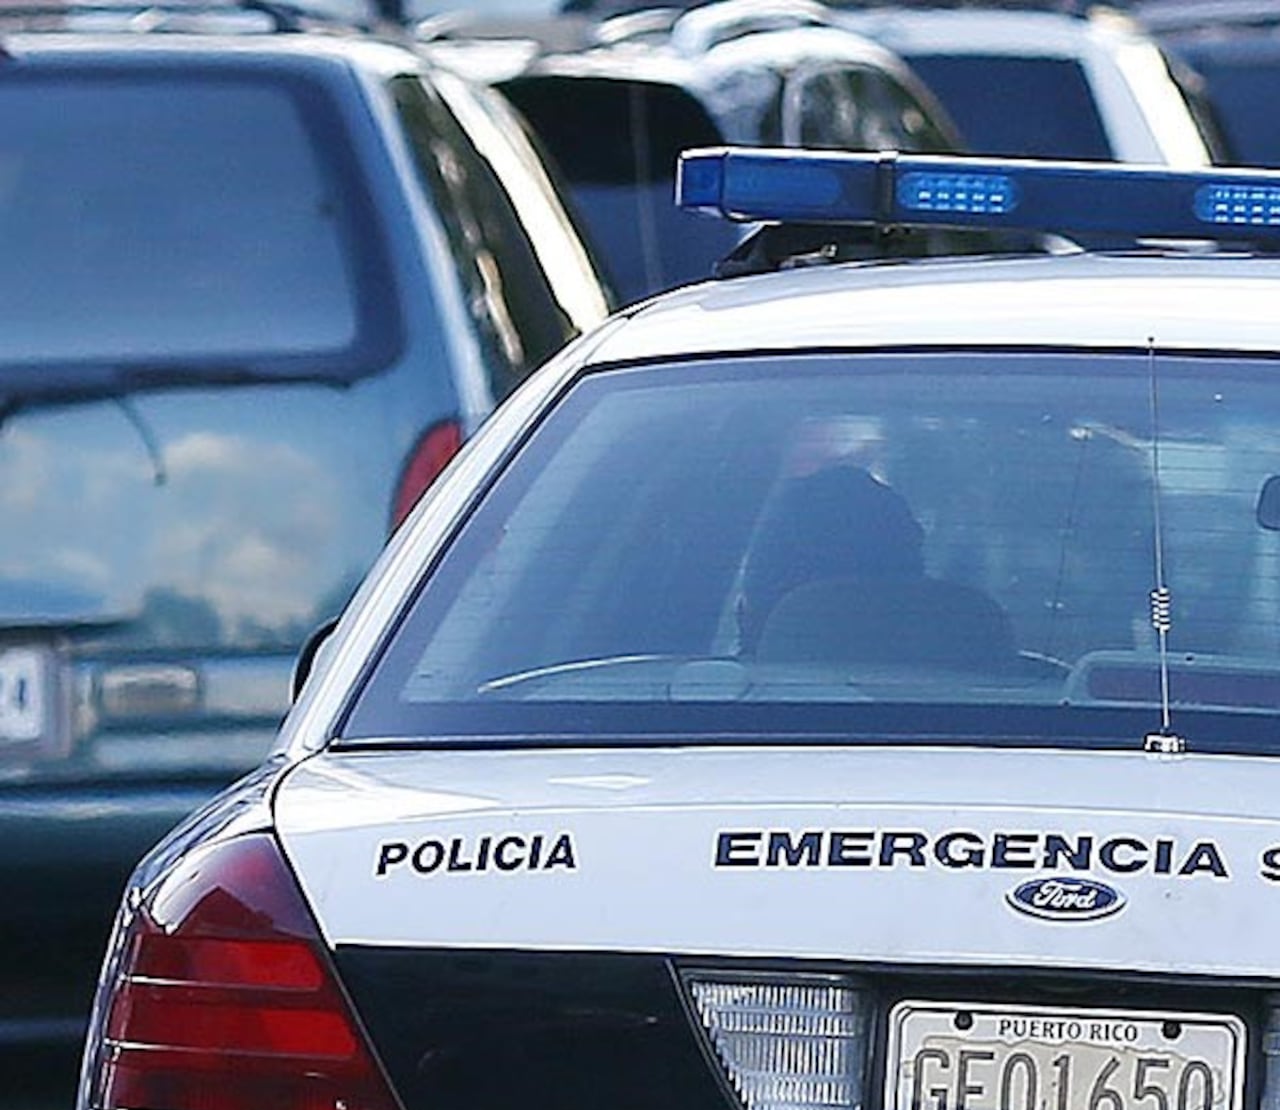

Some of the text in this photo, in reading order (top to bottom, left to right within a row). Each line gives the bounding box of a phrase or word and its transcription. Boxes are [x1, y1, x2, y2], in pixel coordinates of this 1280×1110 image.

[375, 833, 579, 876] POLICIA
[714, 830, 1228, 878] EMERGENCIA
[1032, 880, 1098, 909] Ford
[998, 1018, 1139, 1043] PUERTO RICO
